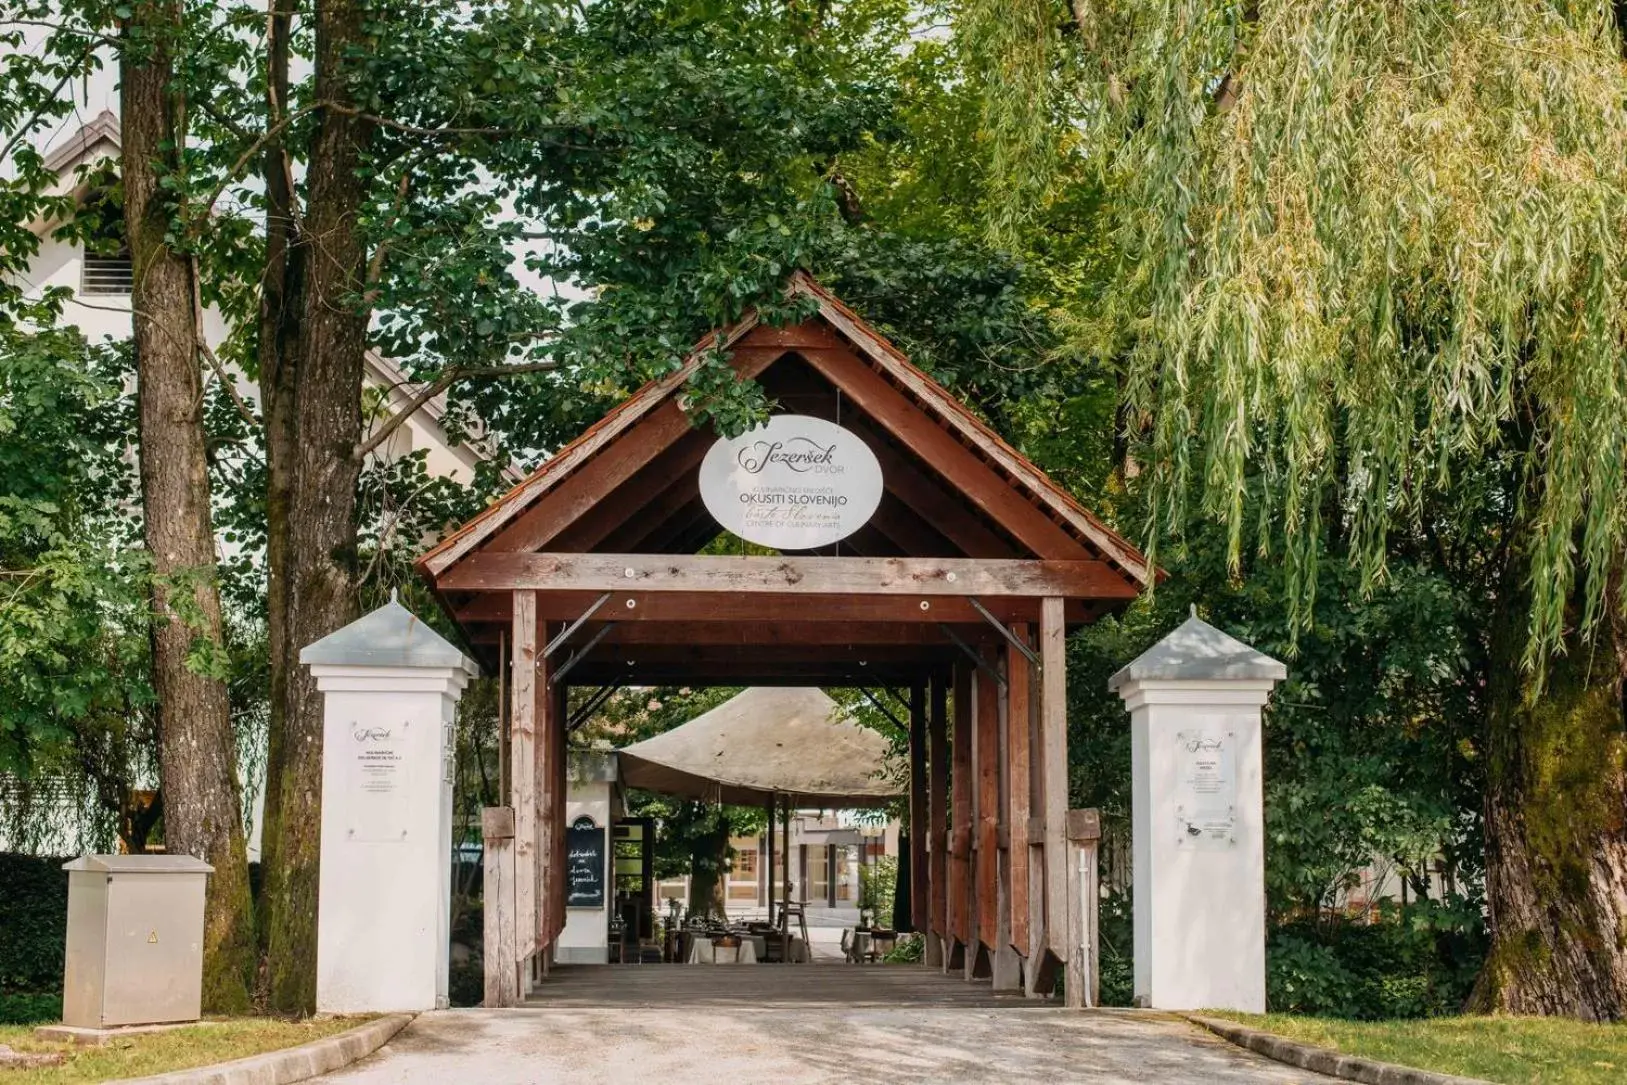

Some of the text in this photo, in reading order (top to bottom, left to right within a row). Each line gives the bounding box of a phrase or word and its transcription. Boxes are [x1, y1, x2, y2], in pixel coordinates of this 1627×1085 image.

[738, 437, 836, 474] Jezeršek
[814, 465, 845, 474] DVOR
[739, 493, 848, 508] OKUSITI SLOVENIJO
